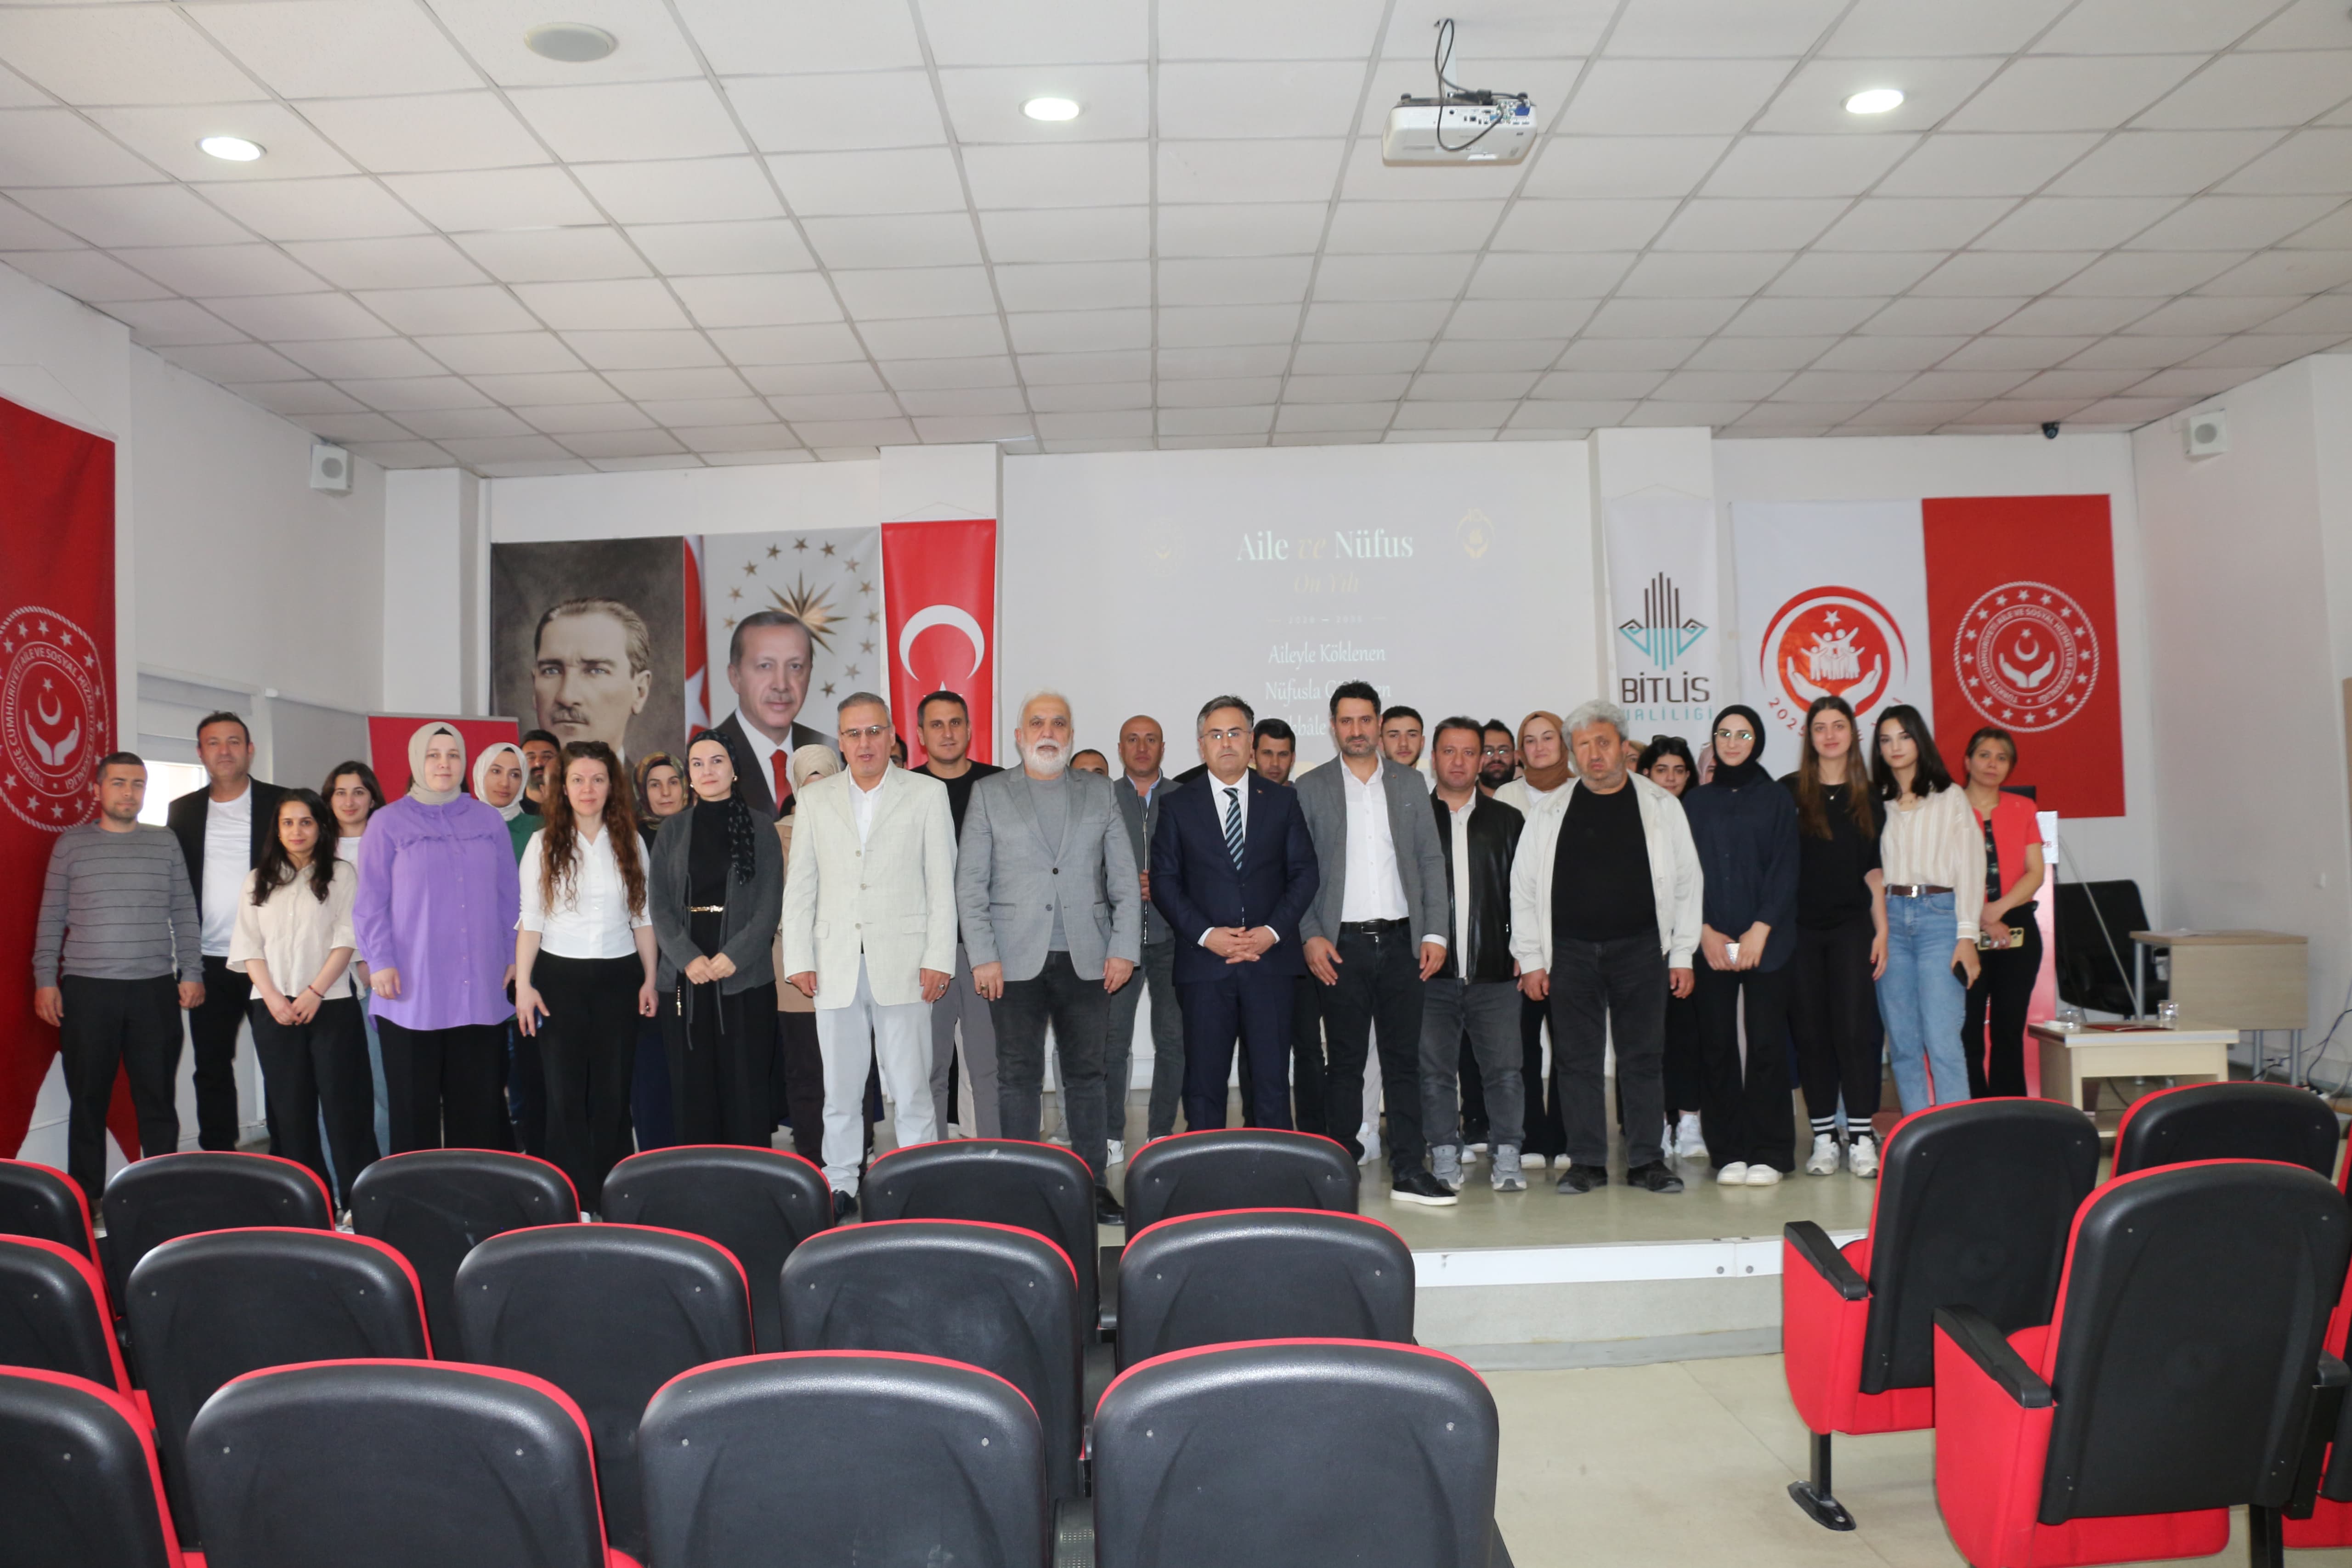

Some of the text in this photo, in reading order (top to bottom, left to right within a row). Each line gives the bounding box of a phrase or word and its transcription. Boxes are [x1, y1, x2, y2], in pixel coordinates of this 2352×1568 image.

[1236, 528, 1414, 560] Aile ve Nüfus
[1294, 573, 1322, 594] On
[34, 647, 45, 657] VE
[45, 648, 78, 677] SOSYAL
[1268, 640, 1386, 670] Aileyle Köklenen
[1265, 678, 1321, 707] Nüfusla
[1622, 671, 1710, 703] BİTLİS
